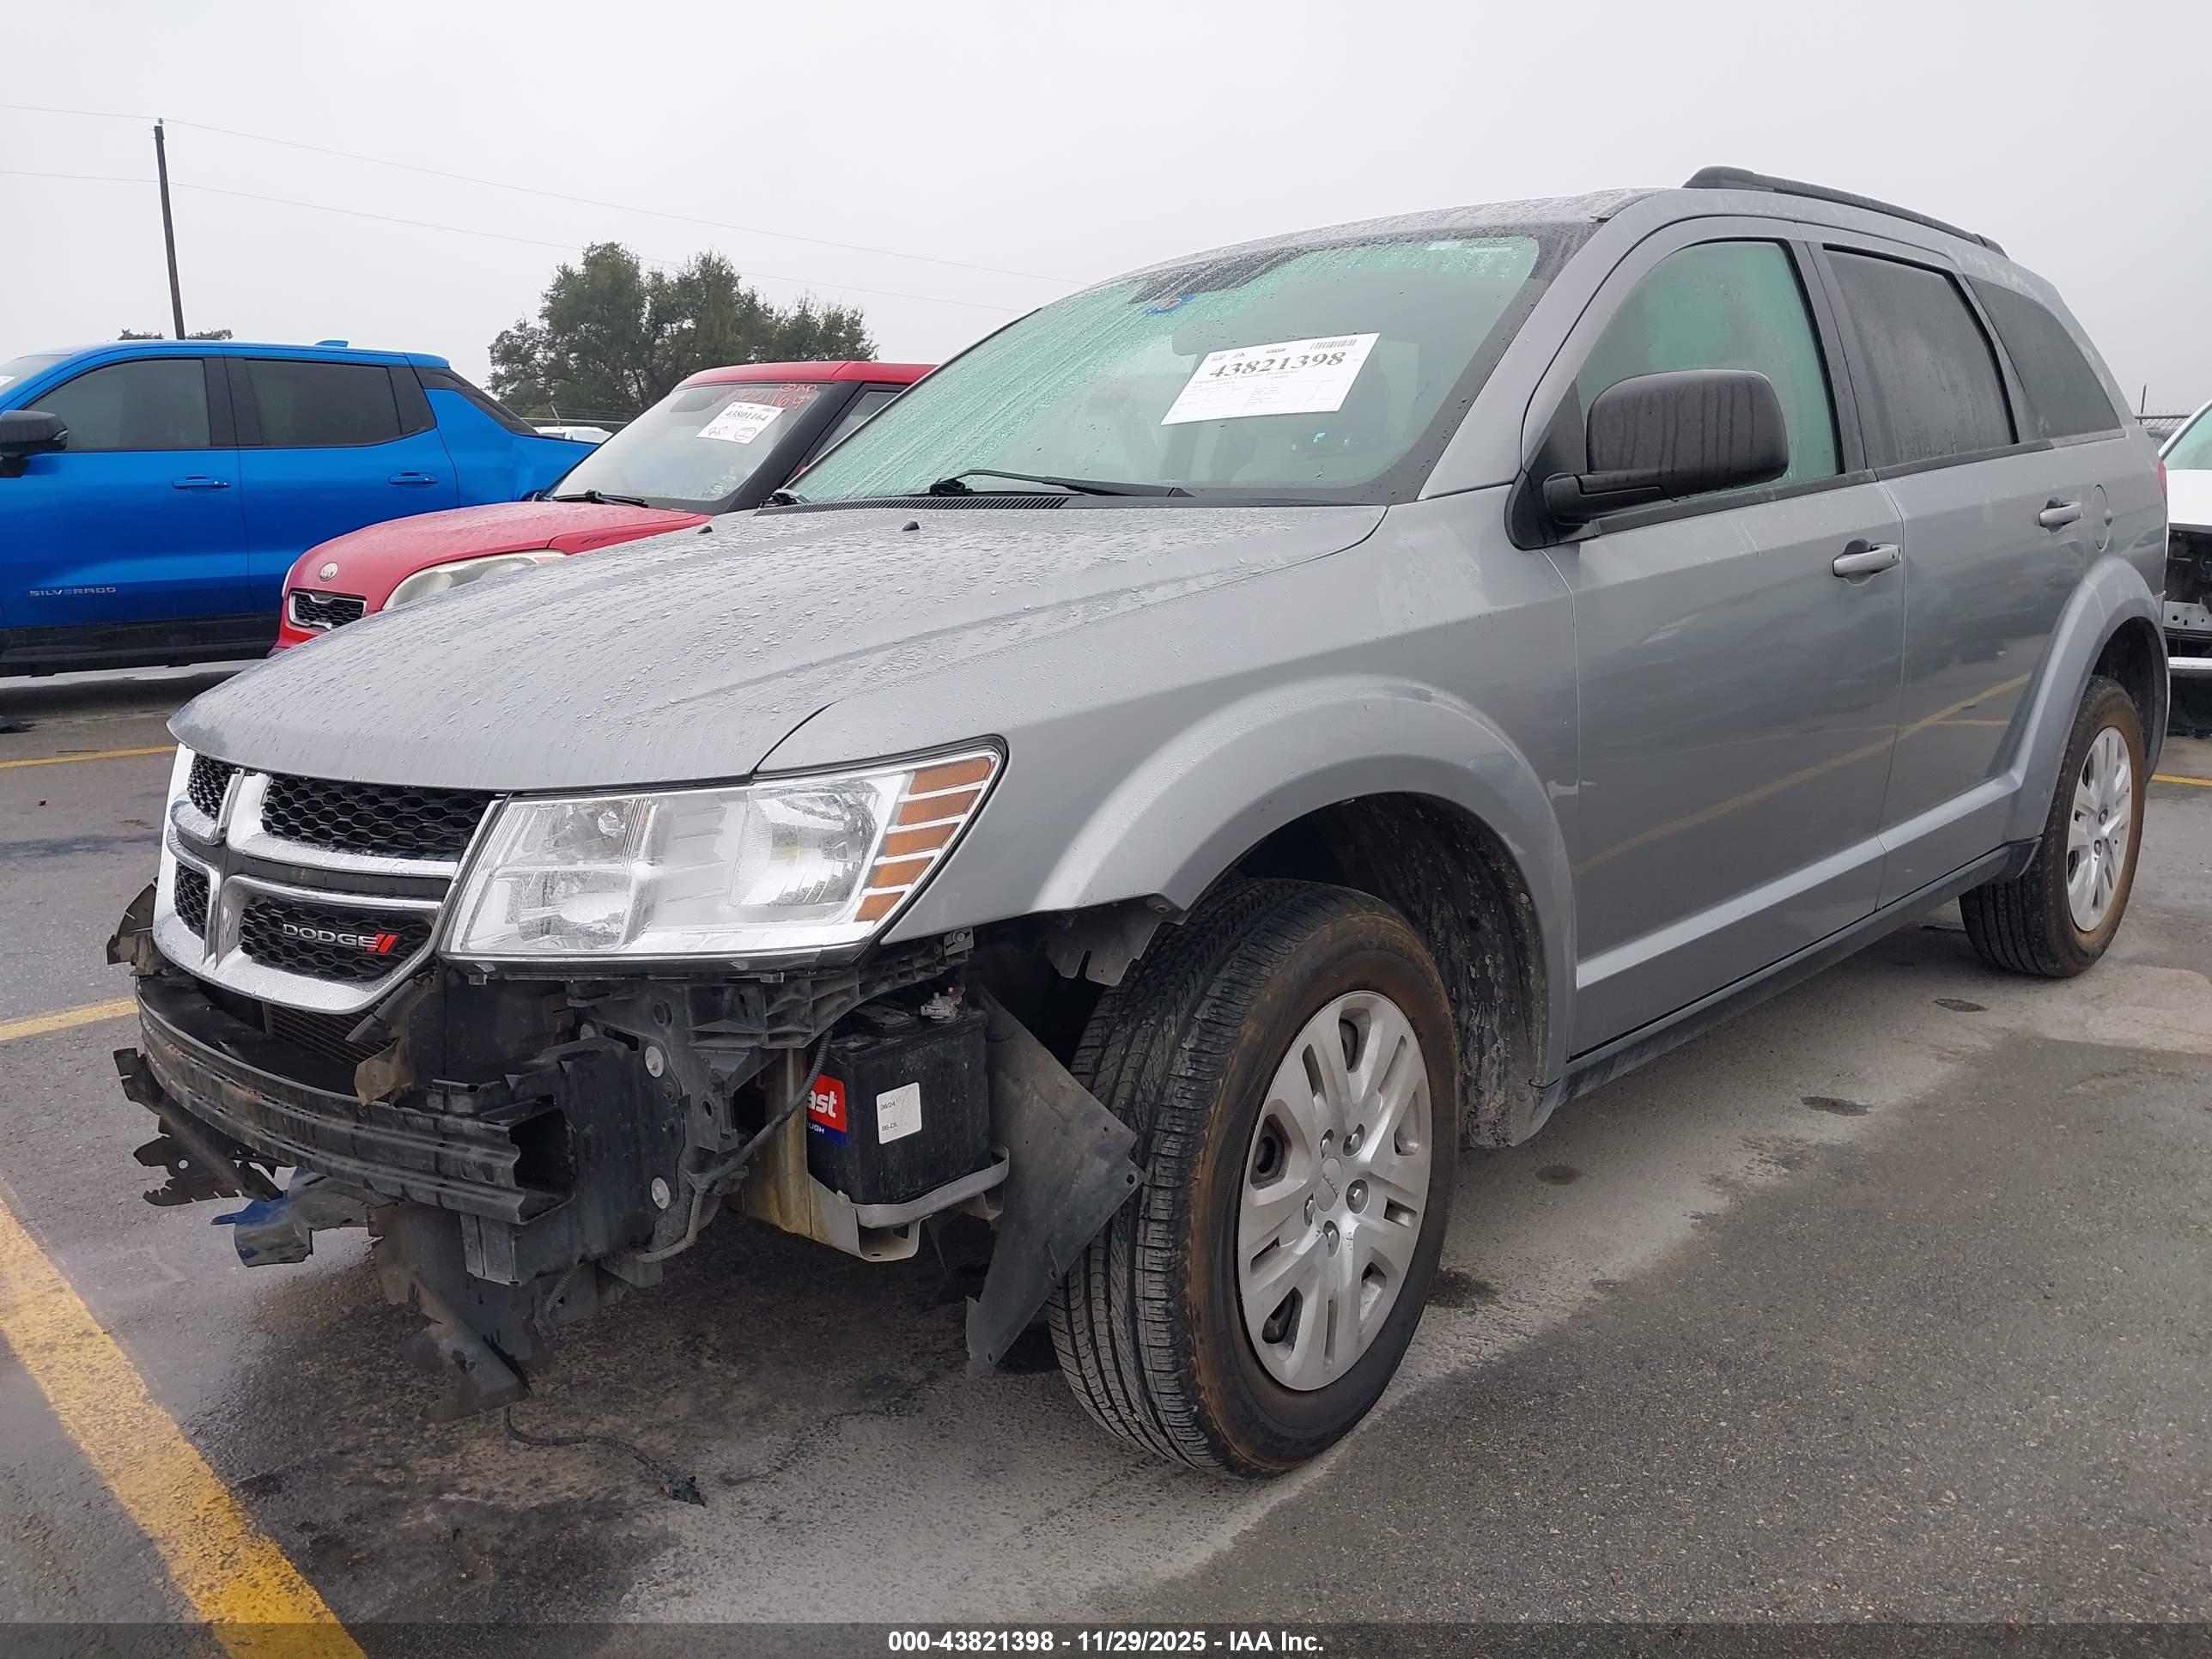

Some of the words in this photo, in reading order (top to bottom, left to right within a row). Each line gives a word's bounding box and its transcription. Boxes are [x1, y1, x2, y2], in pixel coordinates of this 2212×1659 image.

[1209, 351, 1346, 378] 43821398
[29, 586, 117, 597] SILVERADO
[283, 923, 379, 948] DODGE
